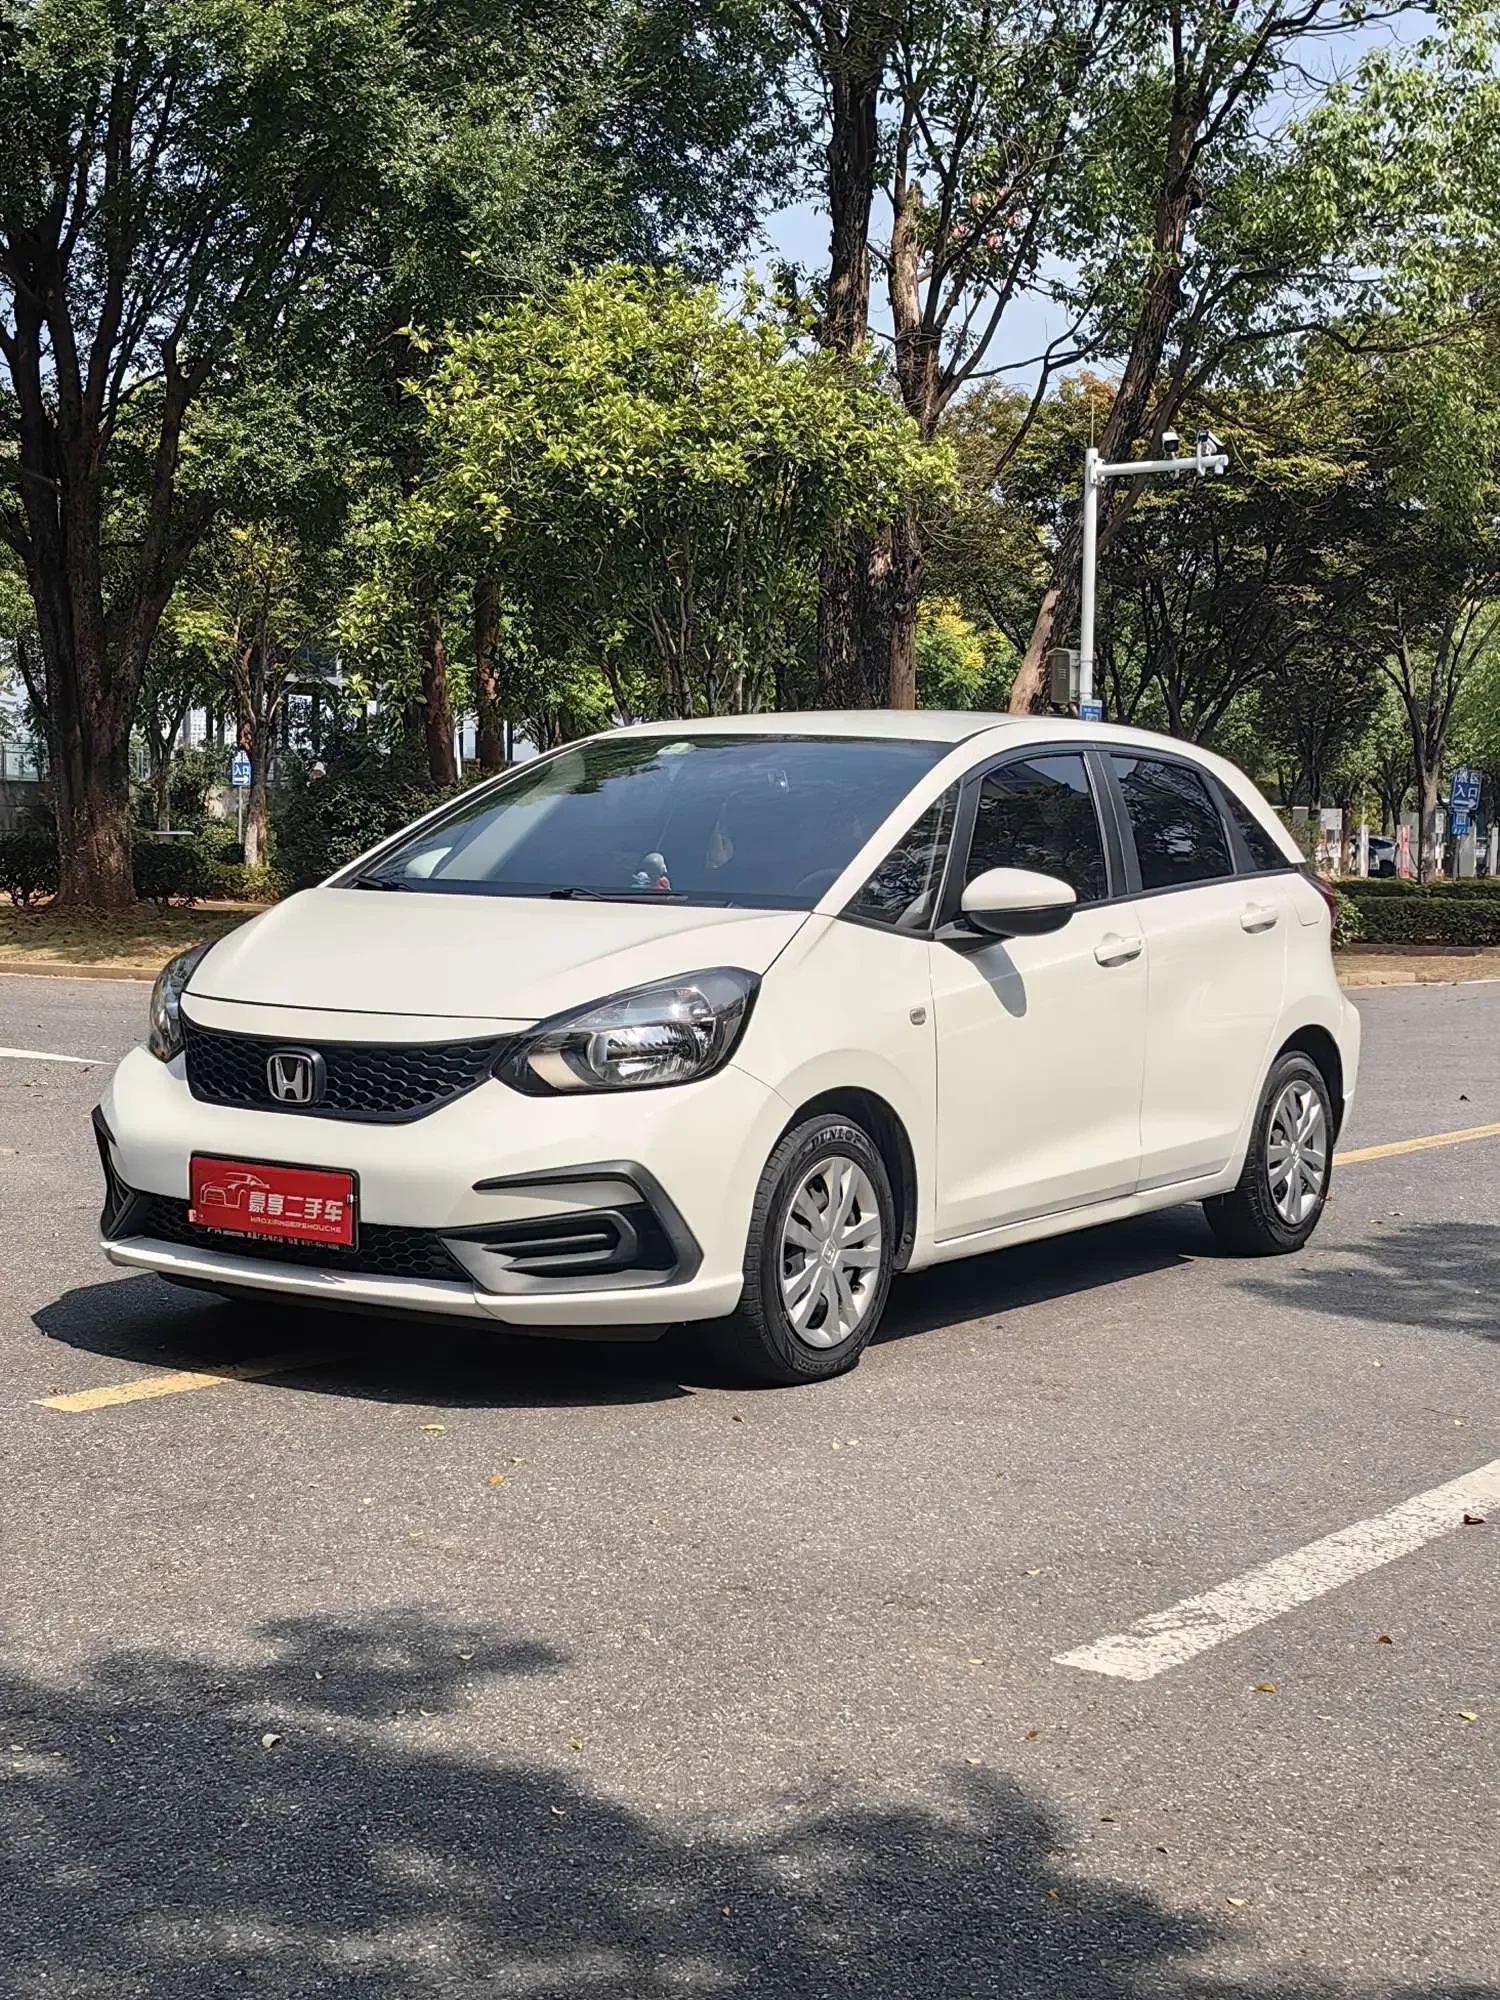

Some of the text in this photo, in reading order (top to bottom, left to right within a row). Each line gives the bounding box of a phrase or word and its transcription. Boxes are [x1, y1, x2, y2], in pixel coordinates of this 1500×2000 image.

[233, 764, 249, 775] 入口
[1455, 785, 1478, 798] 入口
[249, 1191, 343, 1222] 豪享二手车
